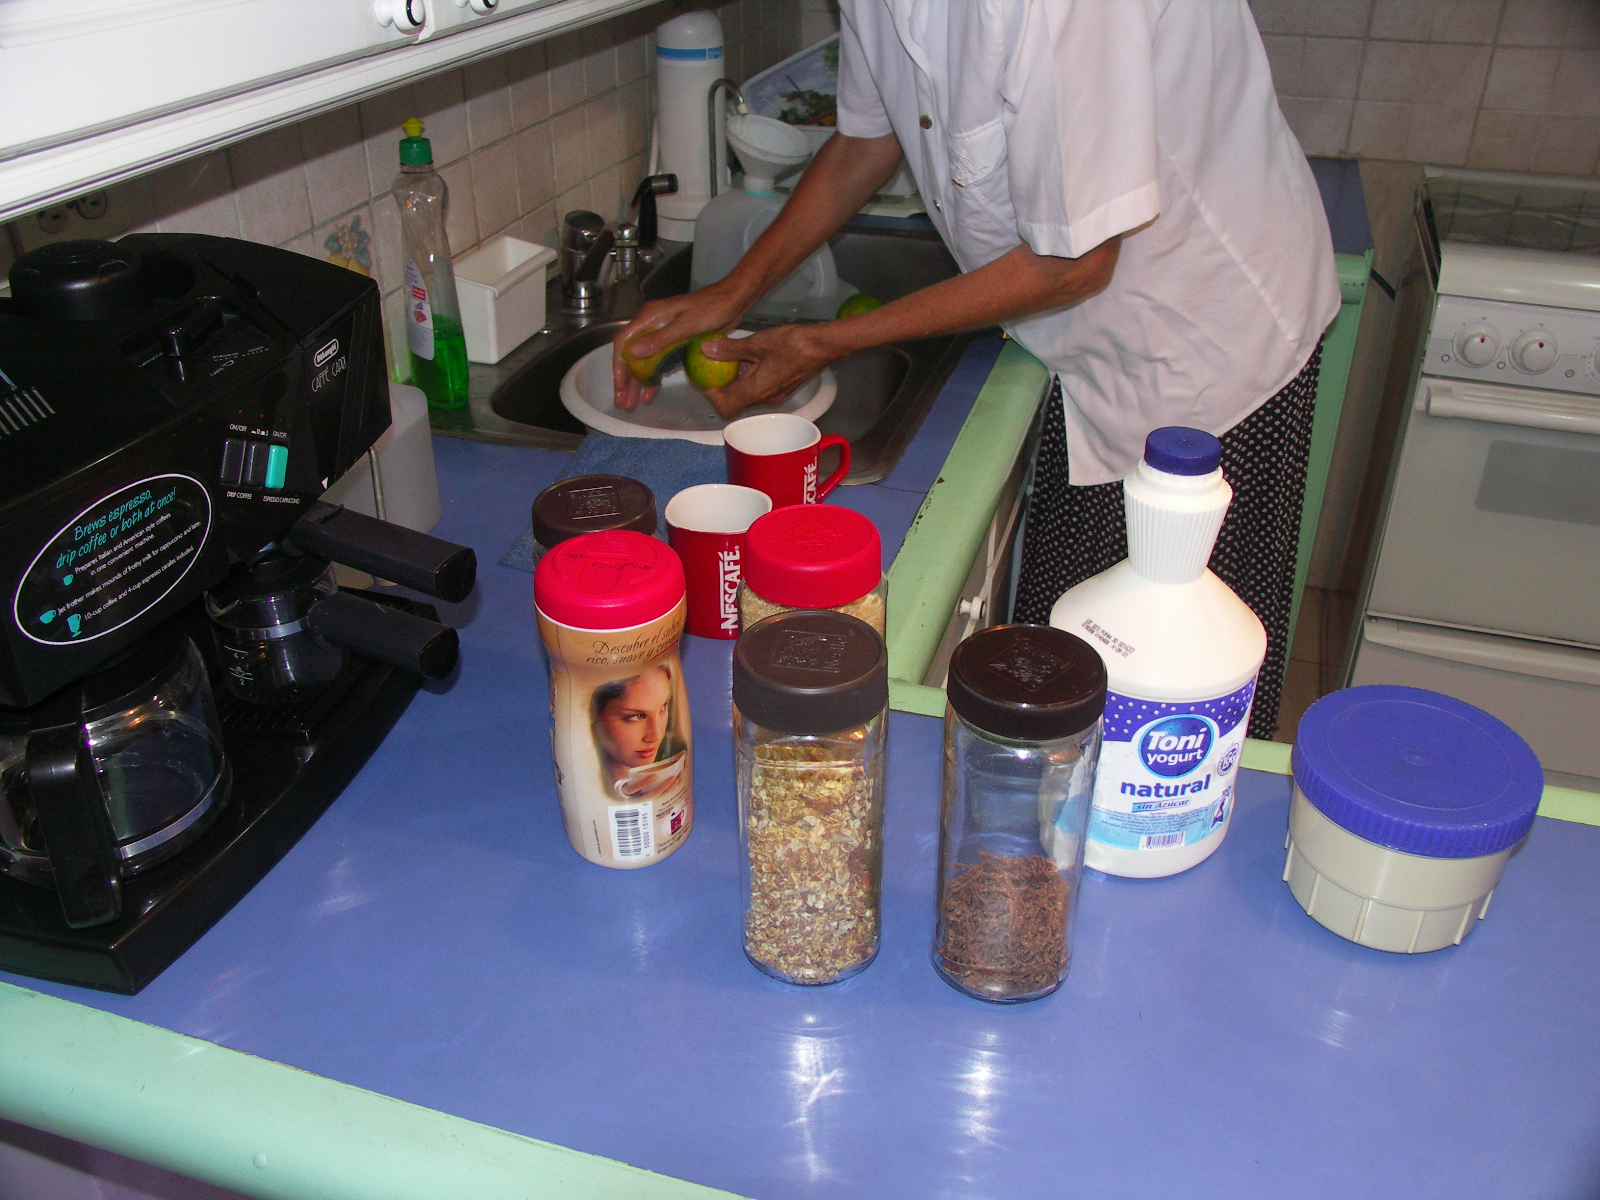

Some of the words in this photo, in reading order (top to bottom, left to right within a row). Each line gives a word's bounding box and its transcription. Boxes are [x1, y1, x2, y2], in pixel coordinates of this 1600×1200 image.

[229, 423, 247, 432] ON/OFF
[273, 430, 288, 438] ON/OFF
[804, 460, 818, 504] CAFÉ
[237, 492, 252, 500] COFFEE
[56, 549, 76, 569] drip
[78, 532, 107, 557] coffee
[110, 525, 119, 539] or
[121, 509, 142, 532] both
[144, 501, 155, 518] at
[156, 486, 176, 510] once!
[74, 515, 107, 541] Brews
[74, 558, 98, 574] Prepares
[98, 549, 113, 560] Italian
[113, 542, 123, 552] and
[123, 528, 145, 546] American
[145, 521, 156, 533] style
[96, 563, 107, 572] one
[108, 546, 134, 566] convenient
[58, 606, 66, 616] Jet
[66, 596, 84, 609] frother
[85, 585, 102, 599] makes
[102, 572, 122, 588] mounds
[122, 567, 128, 576] of
[128, 560, 142, 572] frothy
[142, 553, 152, 562] milk
[160, 533, 183, 552] cappuccino
[183, 526, 191, 536] and
[84, 607, 102, 620] 10-cup
[103, 596, 118, 609] coffee
[118, 589, 128, 600] and
[128, 582, 141, 592] 4-cup
[142, 569, 162, 584] espresso
[162, 559, 176, 571] carafes
[592, 634, 650, 655] Descubre
[652, 626, 664, 644] el
[586, 655, 609, 665] rico,
[612, 651, 646, 665] suave
[643, 648, 656, 664] y
[1147, 728, 1208, 751] Toni
[1146, 749, 1204, 766] yogurt
[1120, 774, 1212, 798] natural
[1136, 802, 1153, 810] sin
[1154, 798, 1190, 809] Azúcar
